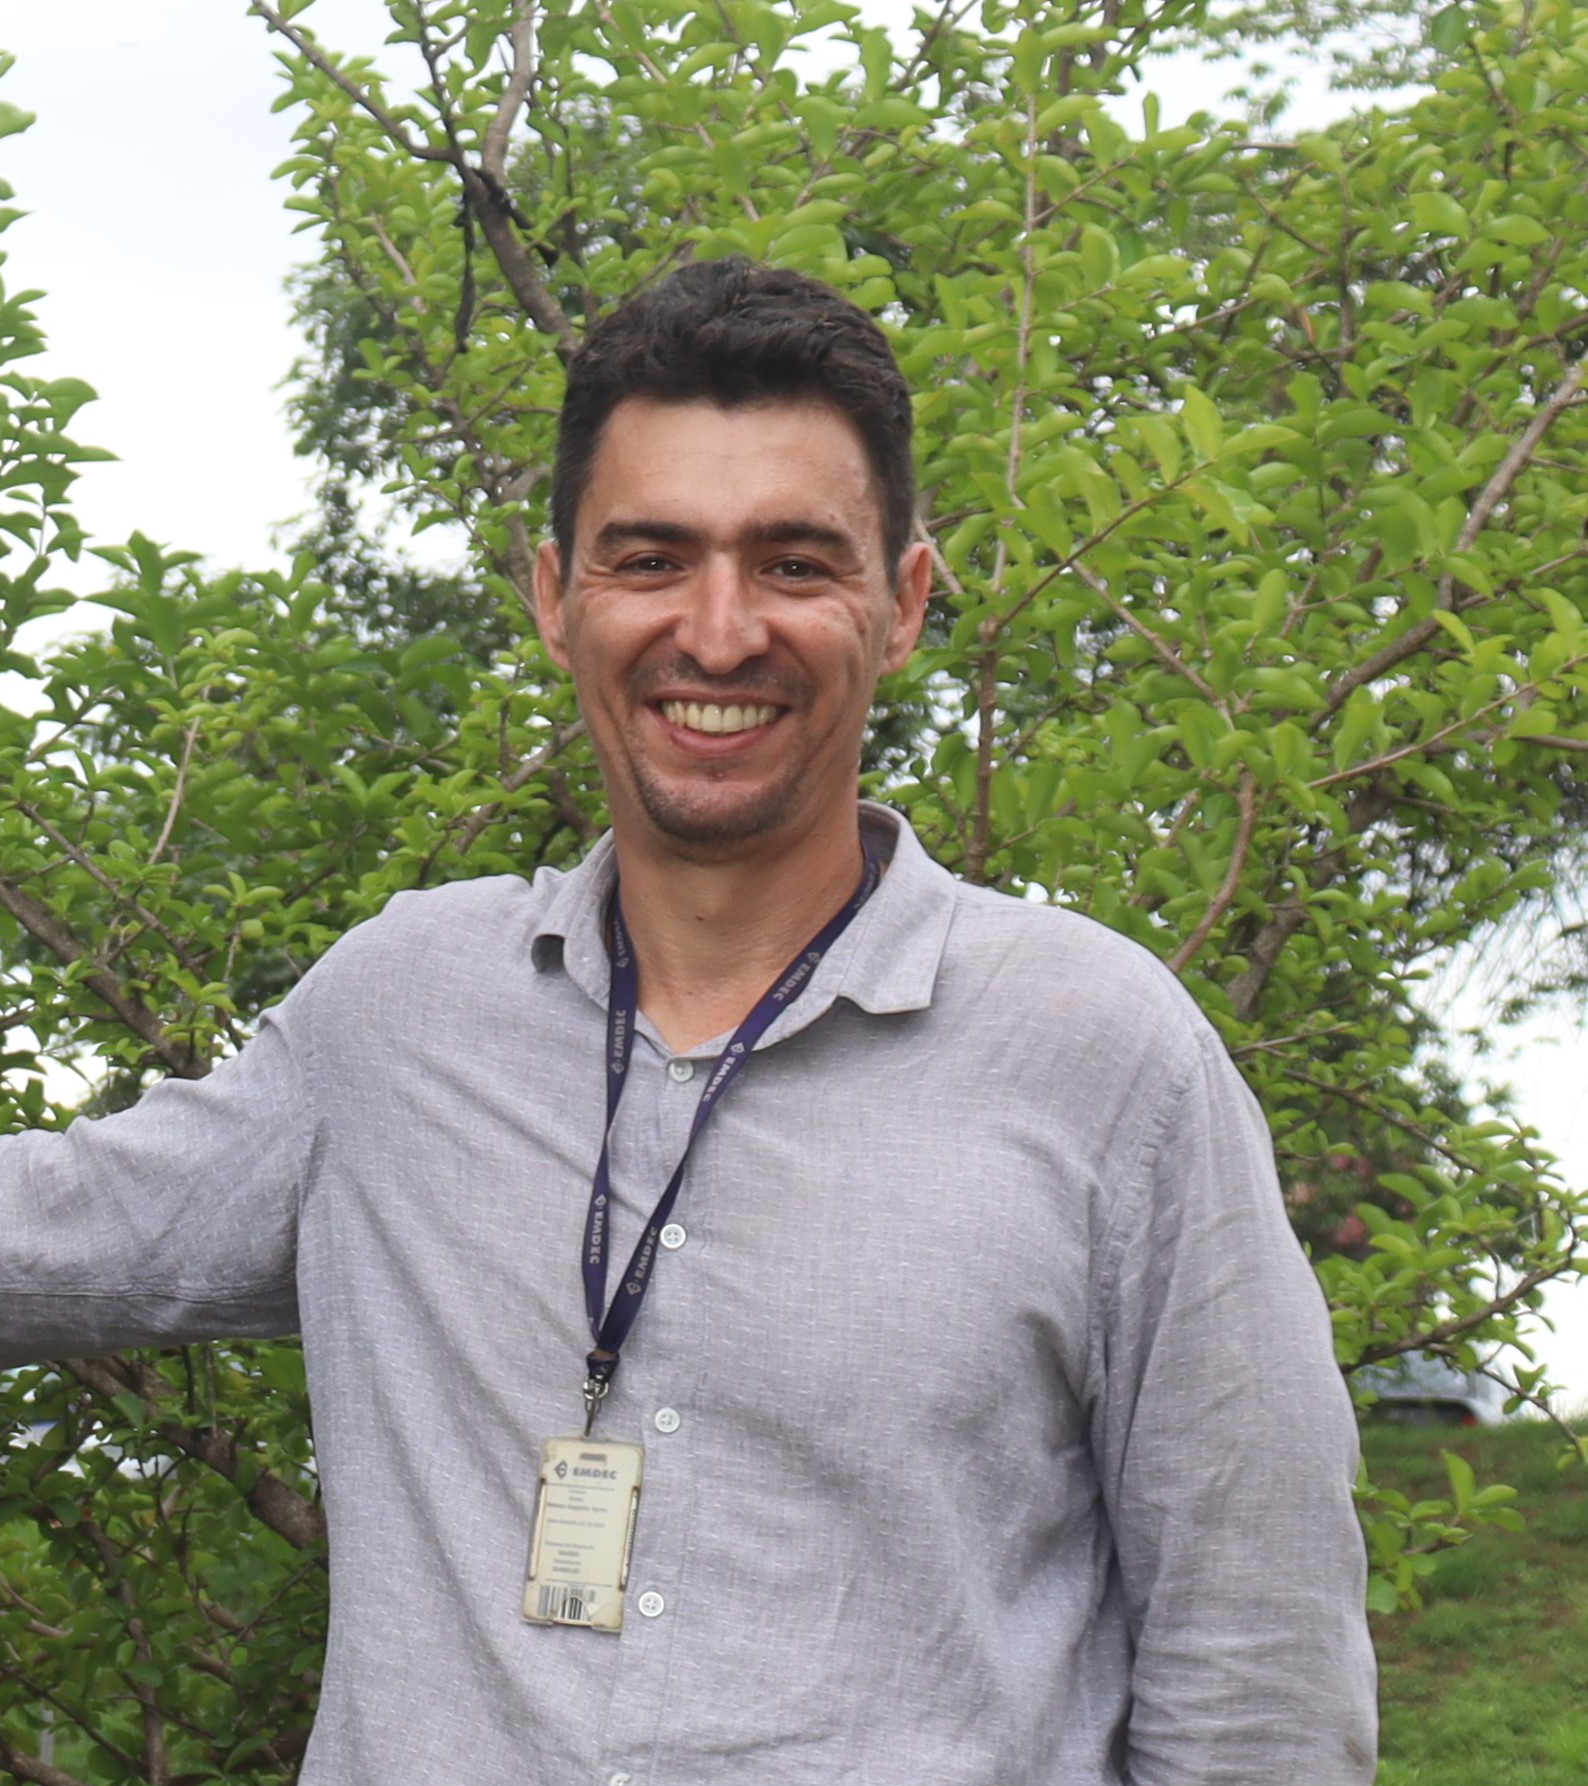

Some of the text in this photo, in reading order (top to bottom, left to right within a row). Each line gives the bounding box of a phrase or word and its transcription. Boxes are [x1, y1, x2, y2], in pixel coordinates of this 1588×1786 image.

[773, 962, 811, 1001] EMDEC
[614, 1009, 626, 1058] EMDEC
[702, 1056, 736, 1102] EMDEC
[589, 1210, 604, 1265] EMDEC
[634, 1226, 658, 1280] EMDEC
[572, 1466, 617, 1480] EMDEC
